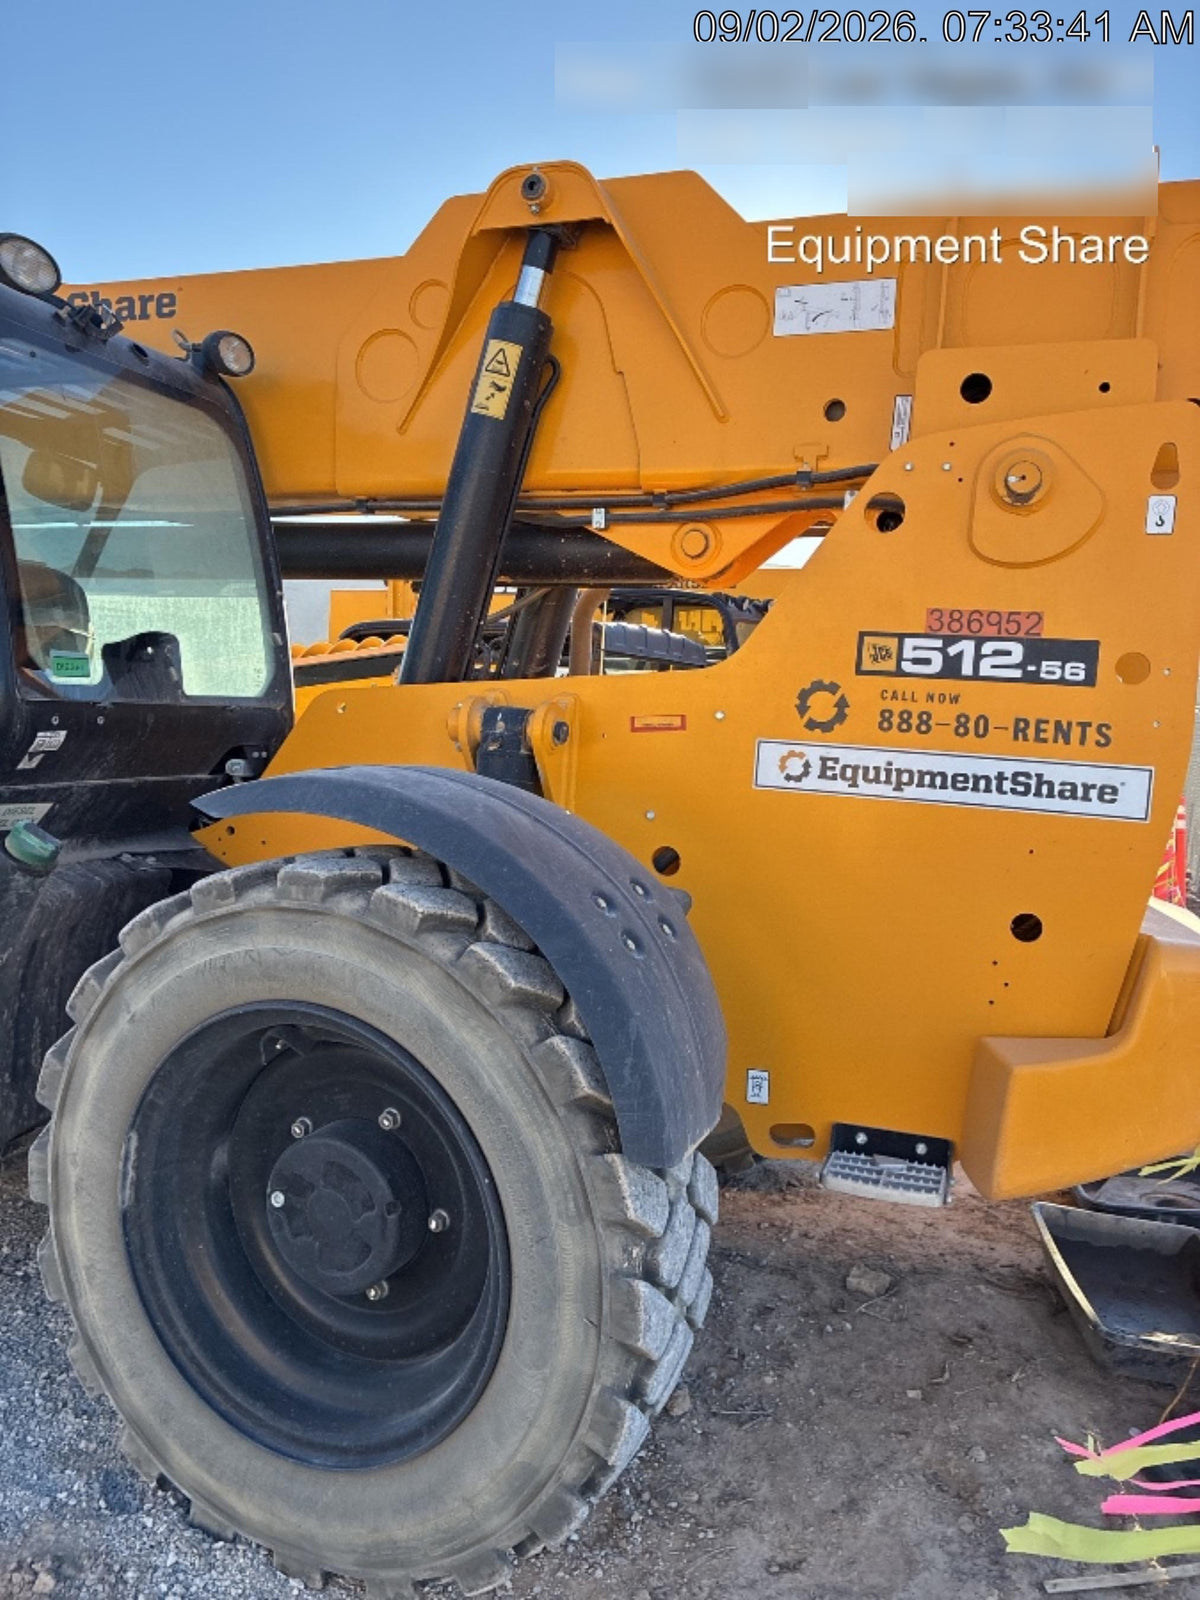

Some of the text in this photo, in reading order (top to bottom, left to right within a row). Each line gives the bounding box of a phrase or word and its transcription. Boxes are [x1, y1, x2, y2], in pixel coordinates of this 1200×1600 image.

[927, 608, 1043, 637] 386952
[900, 637, 1087, 682] 512-56
[880, 689, 961, 705] CALL NOW
[877, 708, 1113, 749] 888-80-RENTS
[816, 755, 1120, 805] EquipmentShare
